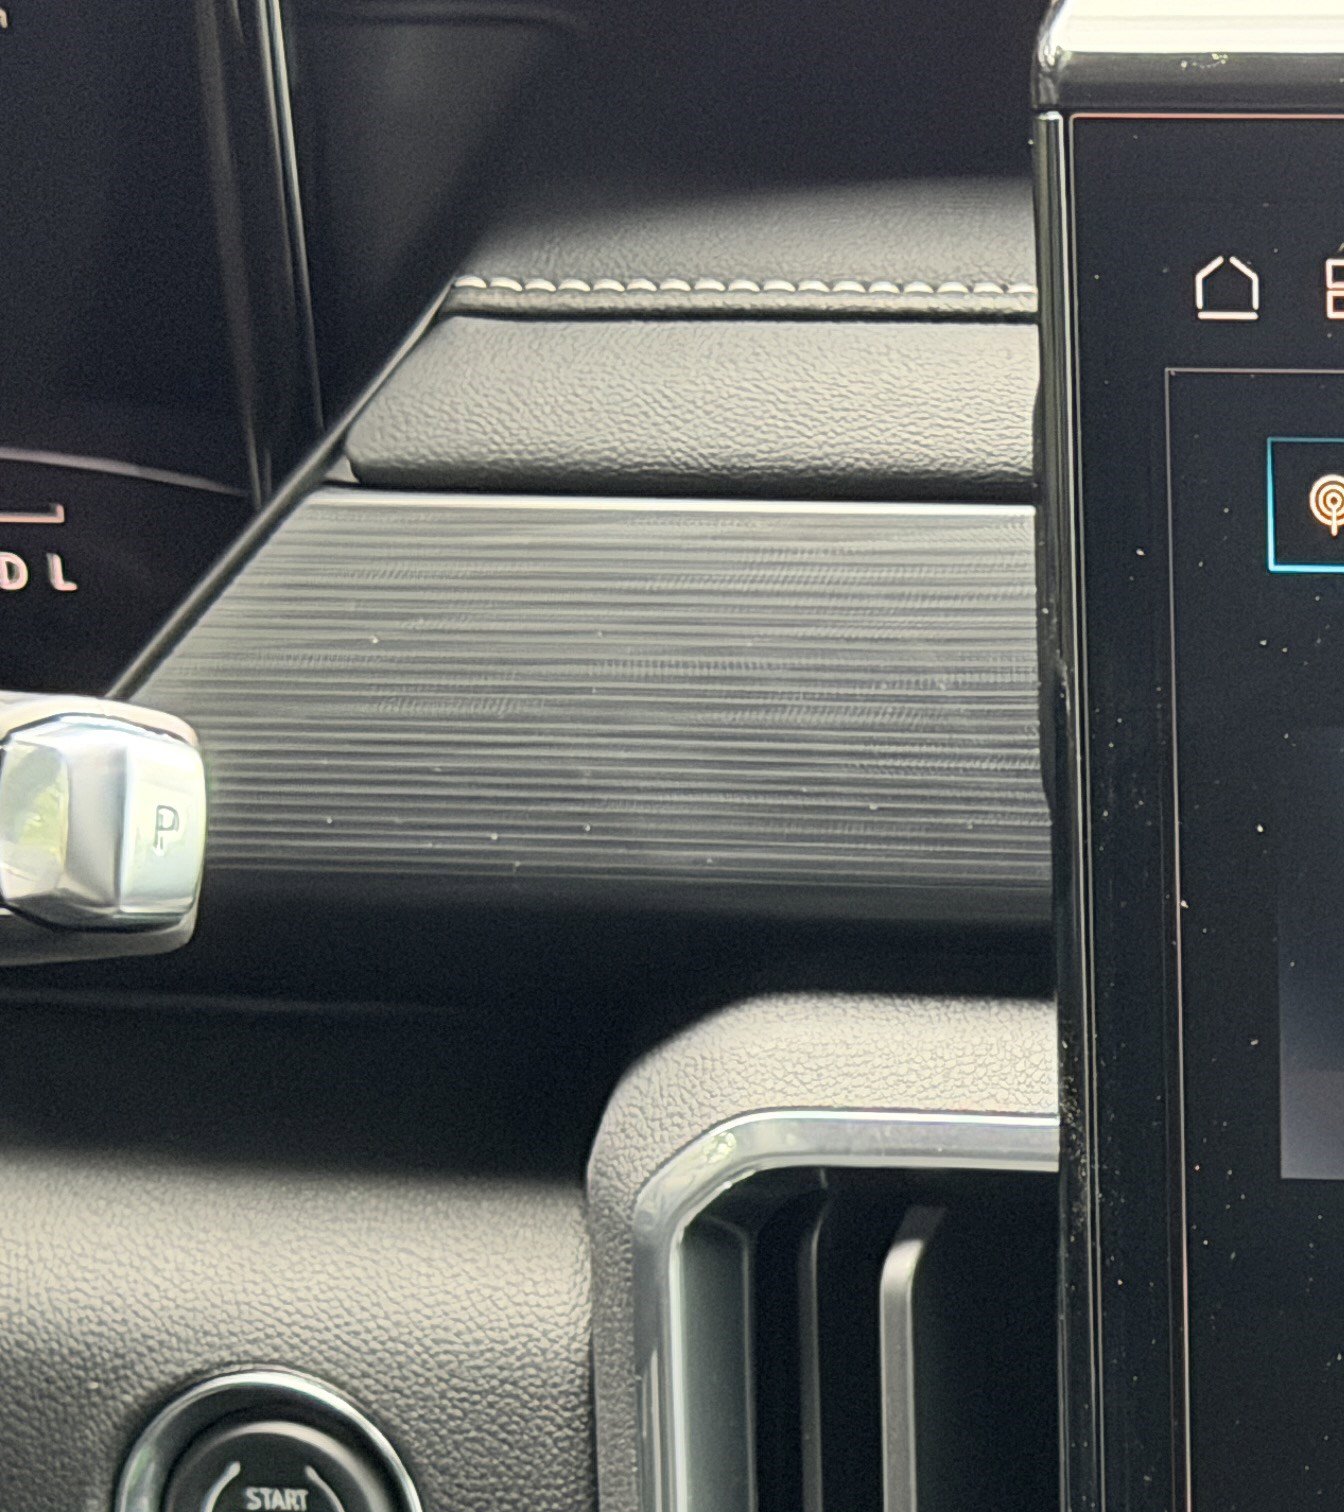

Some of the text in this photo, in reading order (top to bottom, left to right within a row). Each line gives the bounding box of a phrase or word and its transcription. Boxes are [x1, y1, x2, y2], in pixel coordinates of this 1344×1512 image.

[45, 552, 79, 592] L
[152, 804, 180, 852] P
[245, 1487, 309, 1511] START
